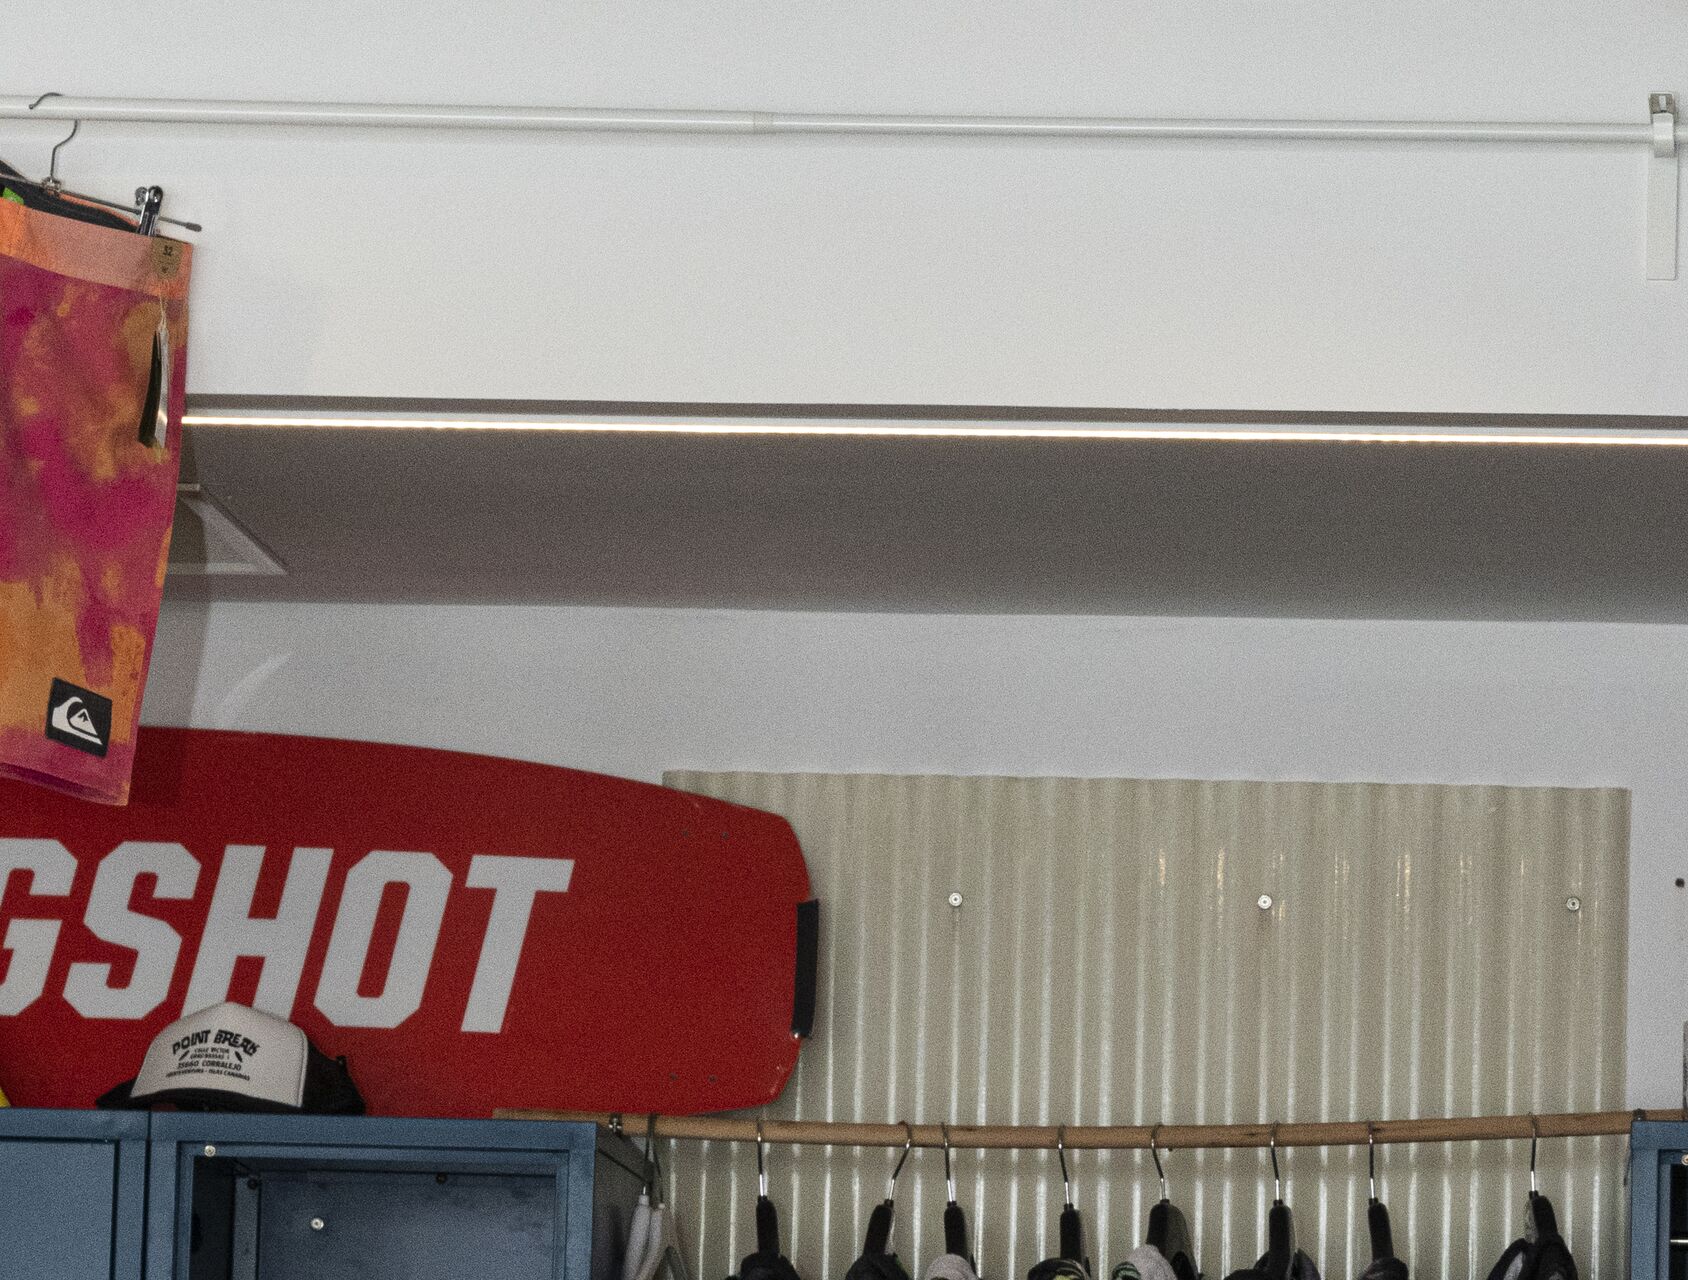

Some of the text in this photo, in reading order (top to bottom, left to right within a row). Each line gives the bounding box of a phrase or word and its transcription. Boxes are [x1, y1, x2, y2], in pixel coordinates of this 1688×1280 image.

[172, 1029, 260, 1056] POINT BREAK
[202, 1060, 242, 1070] CORRALEJO
